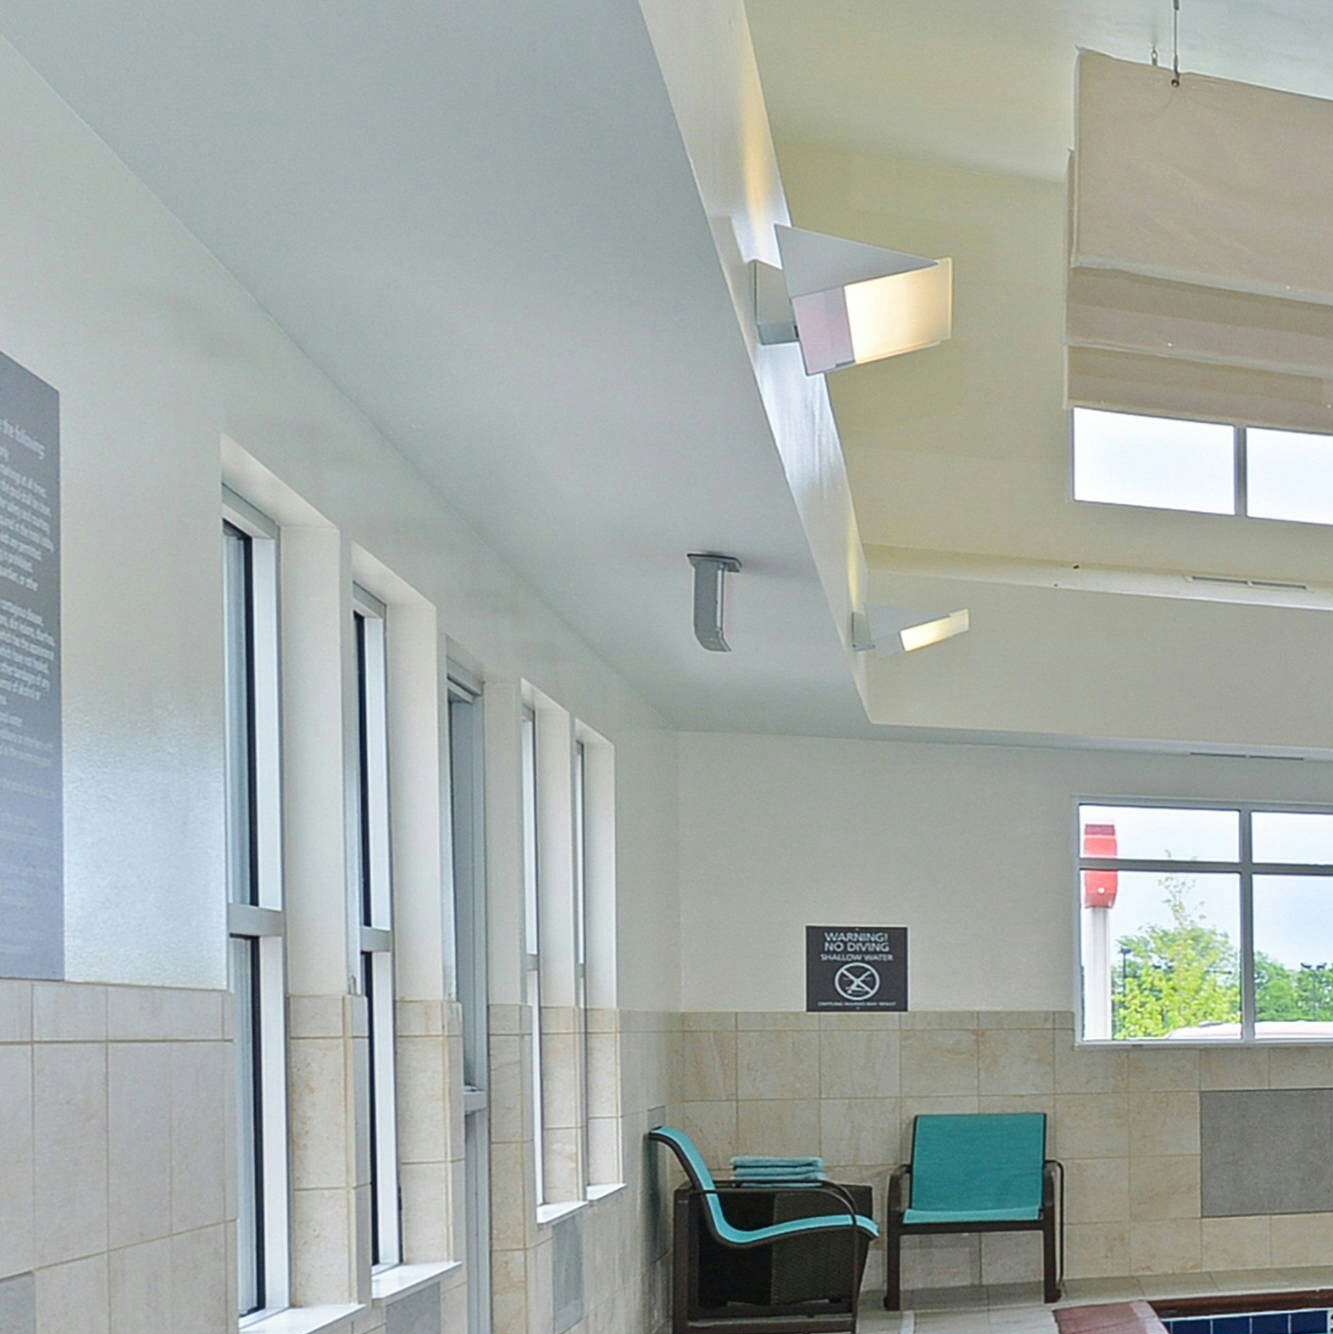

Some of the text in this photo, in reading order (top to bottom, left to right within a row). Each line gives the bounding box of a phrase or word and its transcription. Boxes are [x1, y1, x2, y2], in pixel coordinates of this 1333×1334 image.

[824, 932, 888, 942] WARNING!
[824, 942, 890, 952] NO DIVING
[820, 953, 894, 961] SHALLOW WATER
